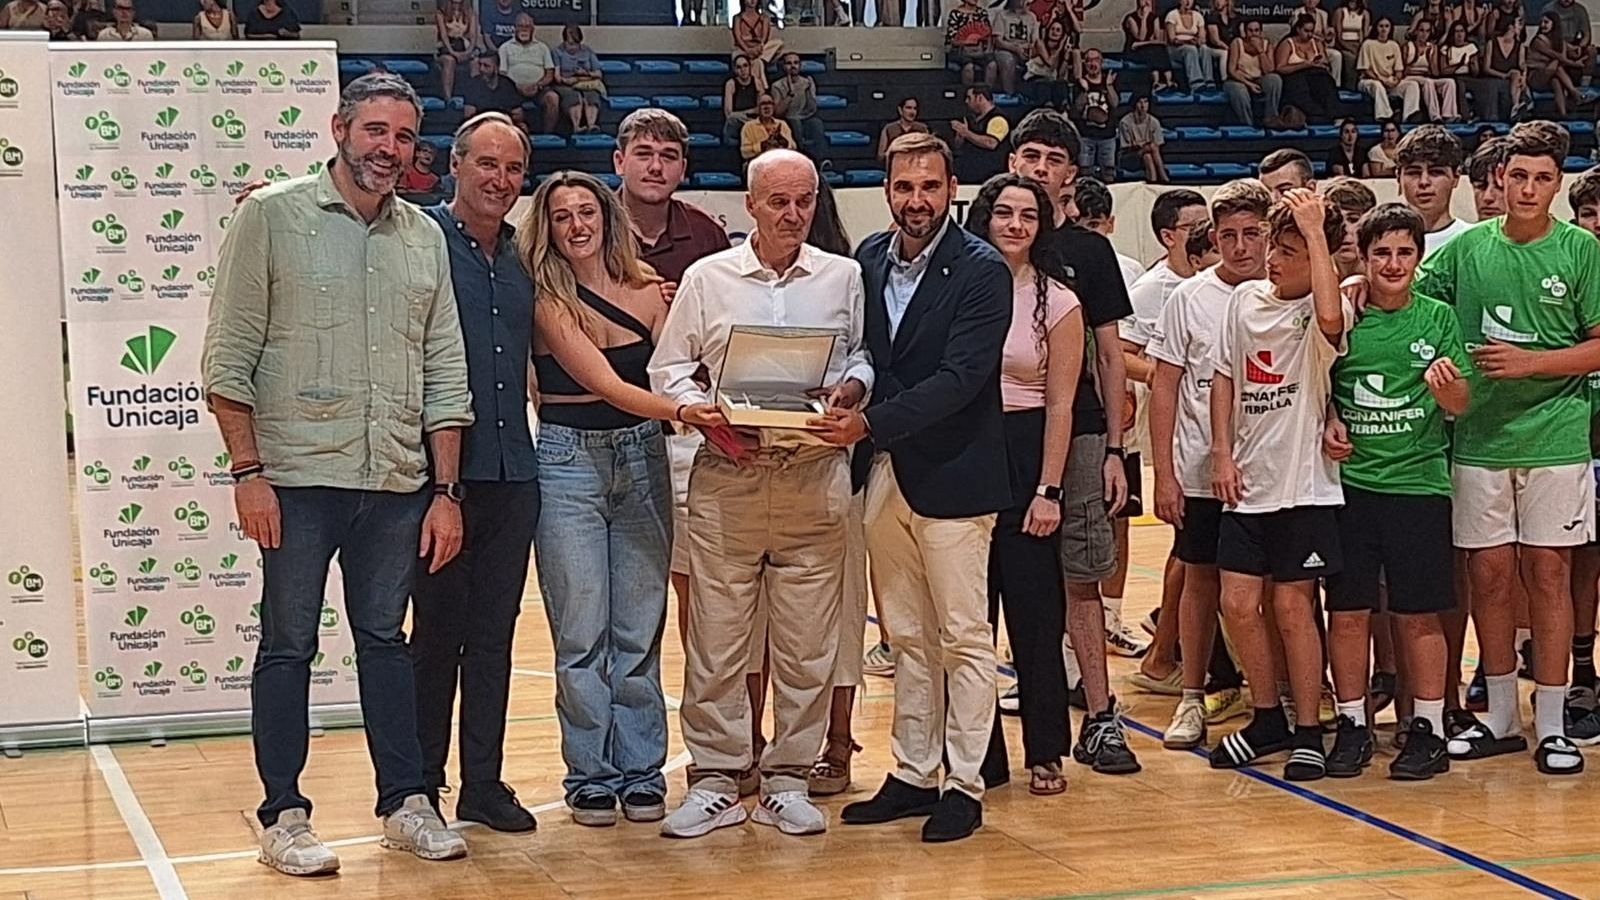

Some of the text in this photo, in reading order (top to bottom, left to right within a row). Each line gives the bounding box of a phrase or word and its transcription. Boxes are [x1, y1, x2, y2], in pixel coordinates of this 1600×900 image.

[87, 381, 205, 406] Fundació
[107, 404, 199, 431] Unicaja
[1342, 407, 1425, 422] CONANIFER
[1351, 421, 1413, 435] TERRALLA
[191, 515, 208, 526] BM
[104, 526, 160, 539] Fundación
[112, 537, 152, 548] Unicaja
[197, 619, 214, 631] BM
[110, 629, 166, 641] Fundación
[118, 639, 159, 651] Unicaja
